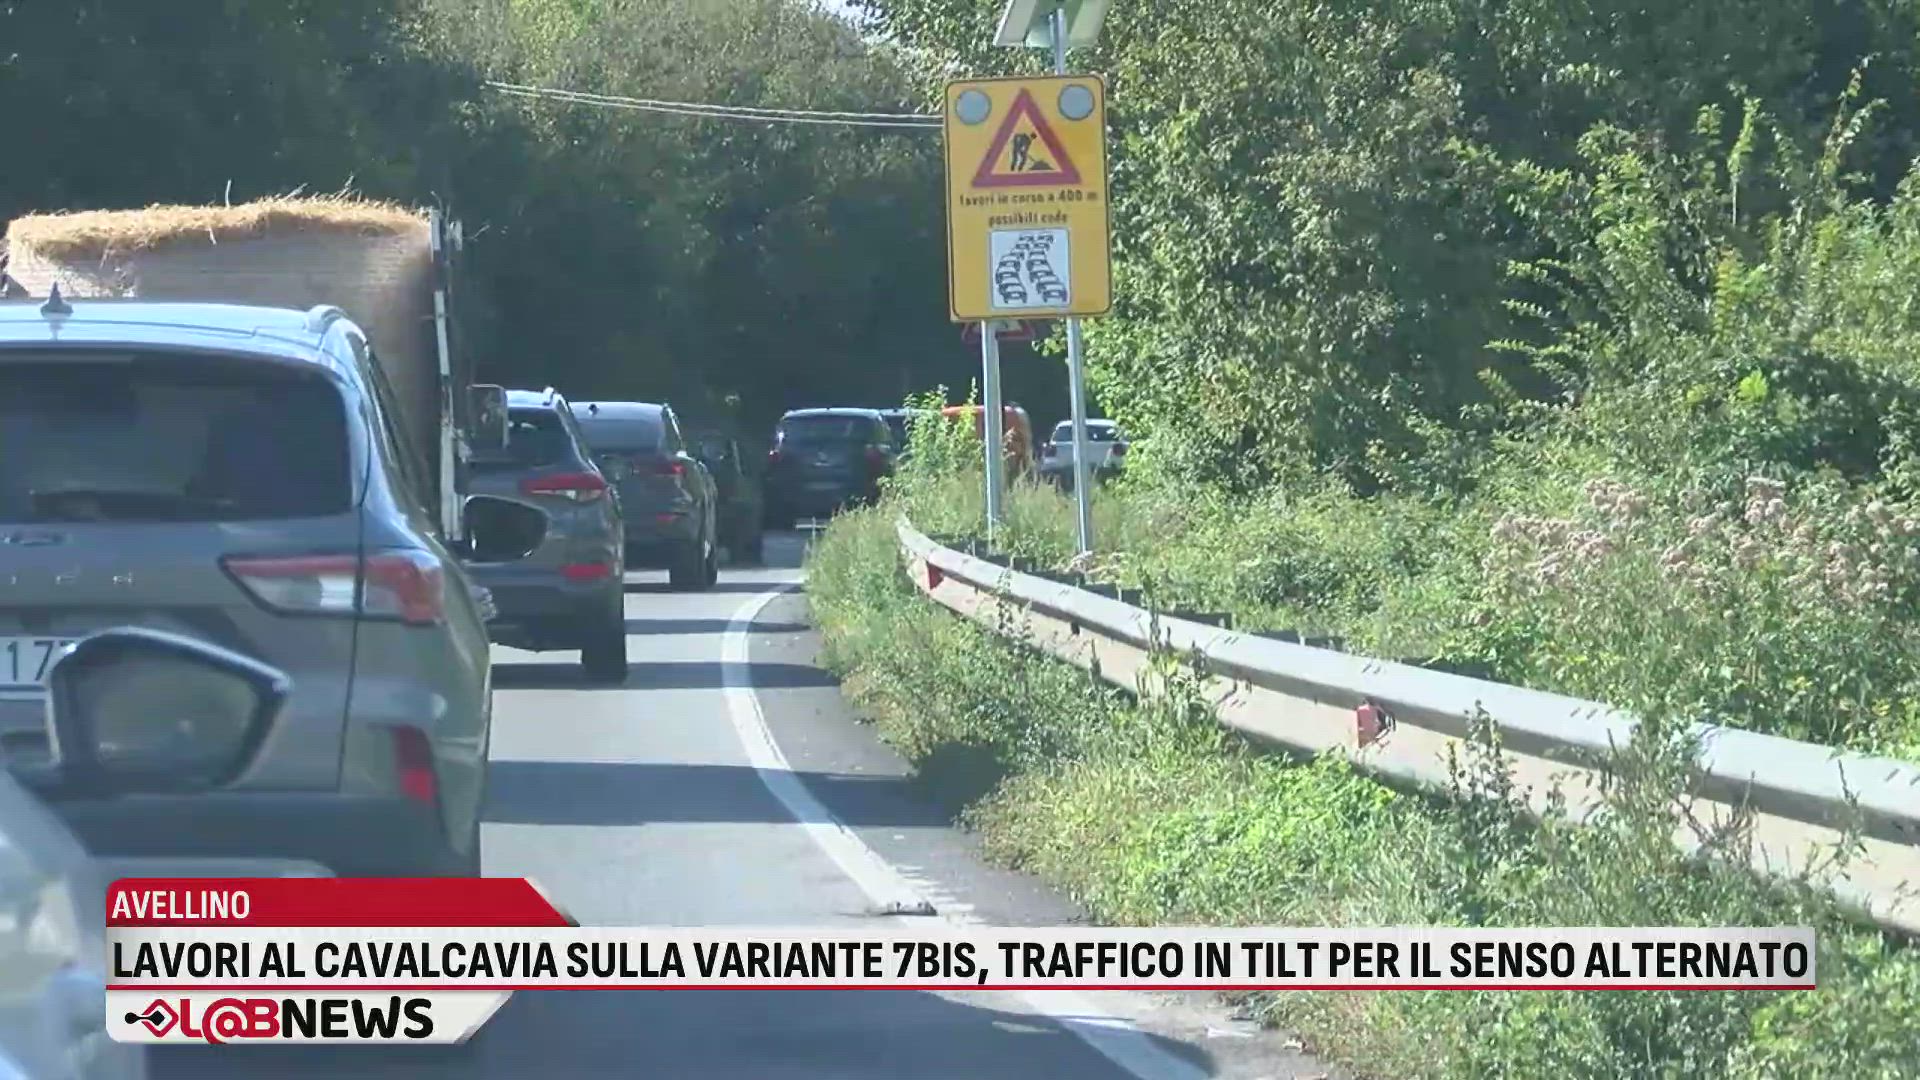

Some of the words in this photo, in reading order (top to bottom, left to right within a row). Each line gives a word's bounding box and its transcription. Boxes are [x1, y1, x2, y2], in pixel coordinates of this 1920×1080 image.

[998, 193, 1009, 204] in
[1012, 193, 1044, 204] corso
[1048, 193, 1055, 202] a
[1058, 190, 1082, 202] 400
[989, 212, 1038, 227] possibili
[1041, 209, 1068, 224] code
